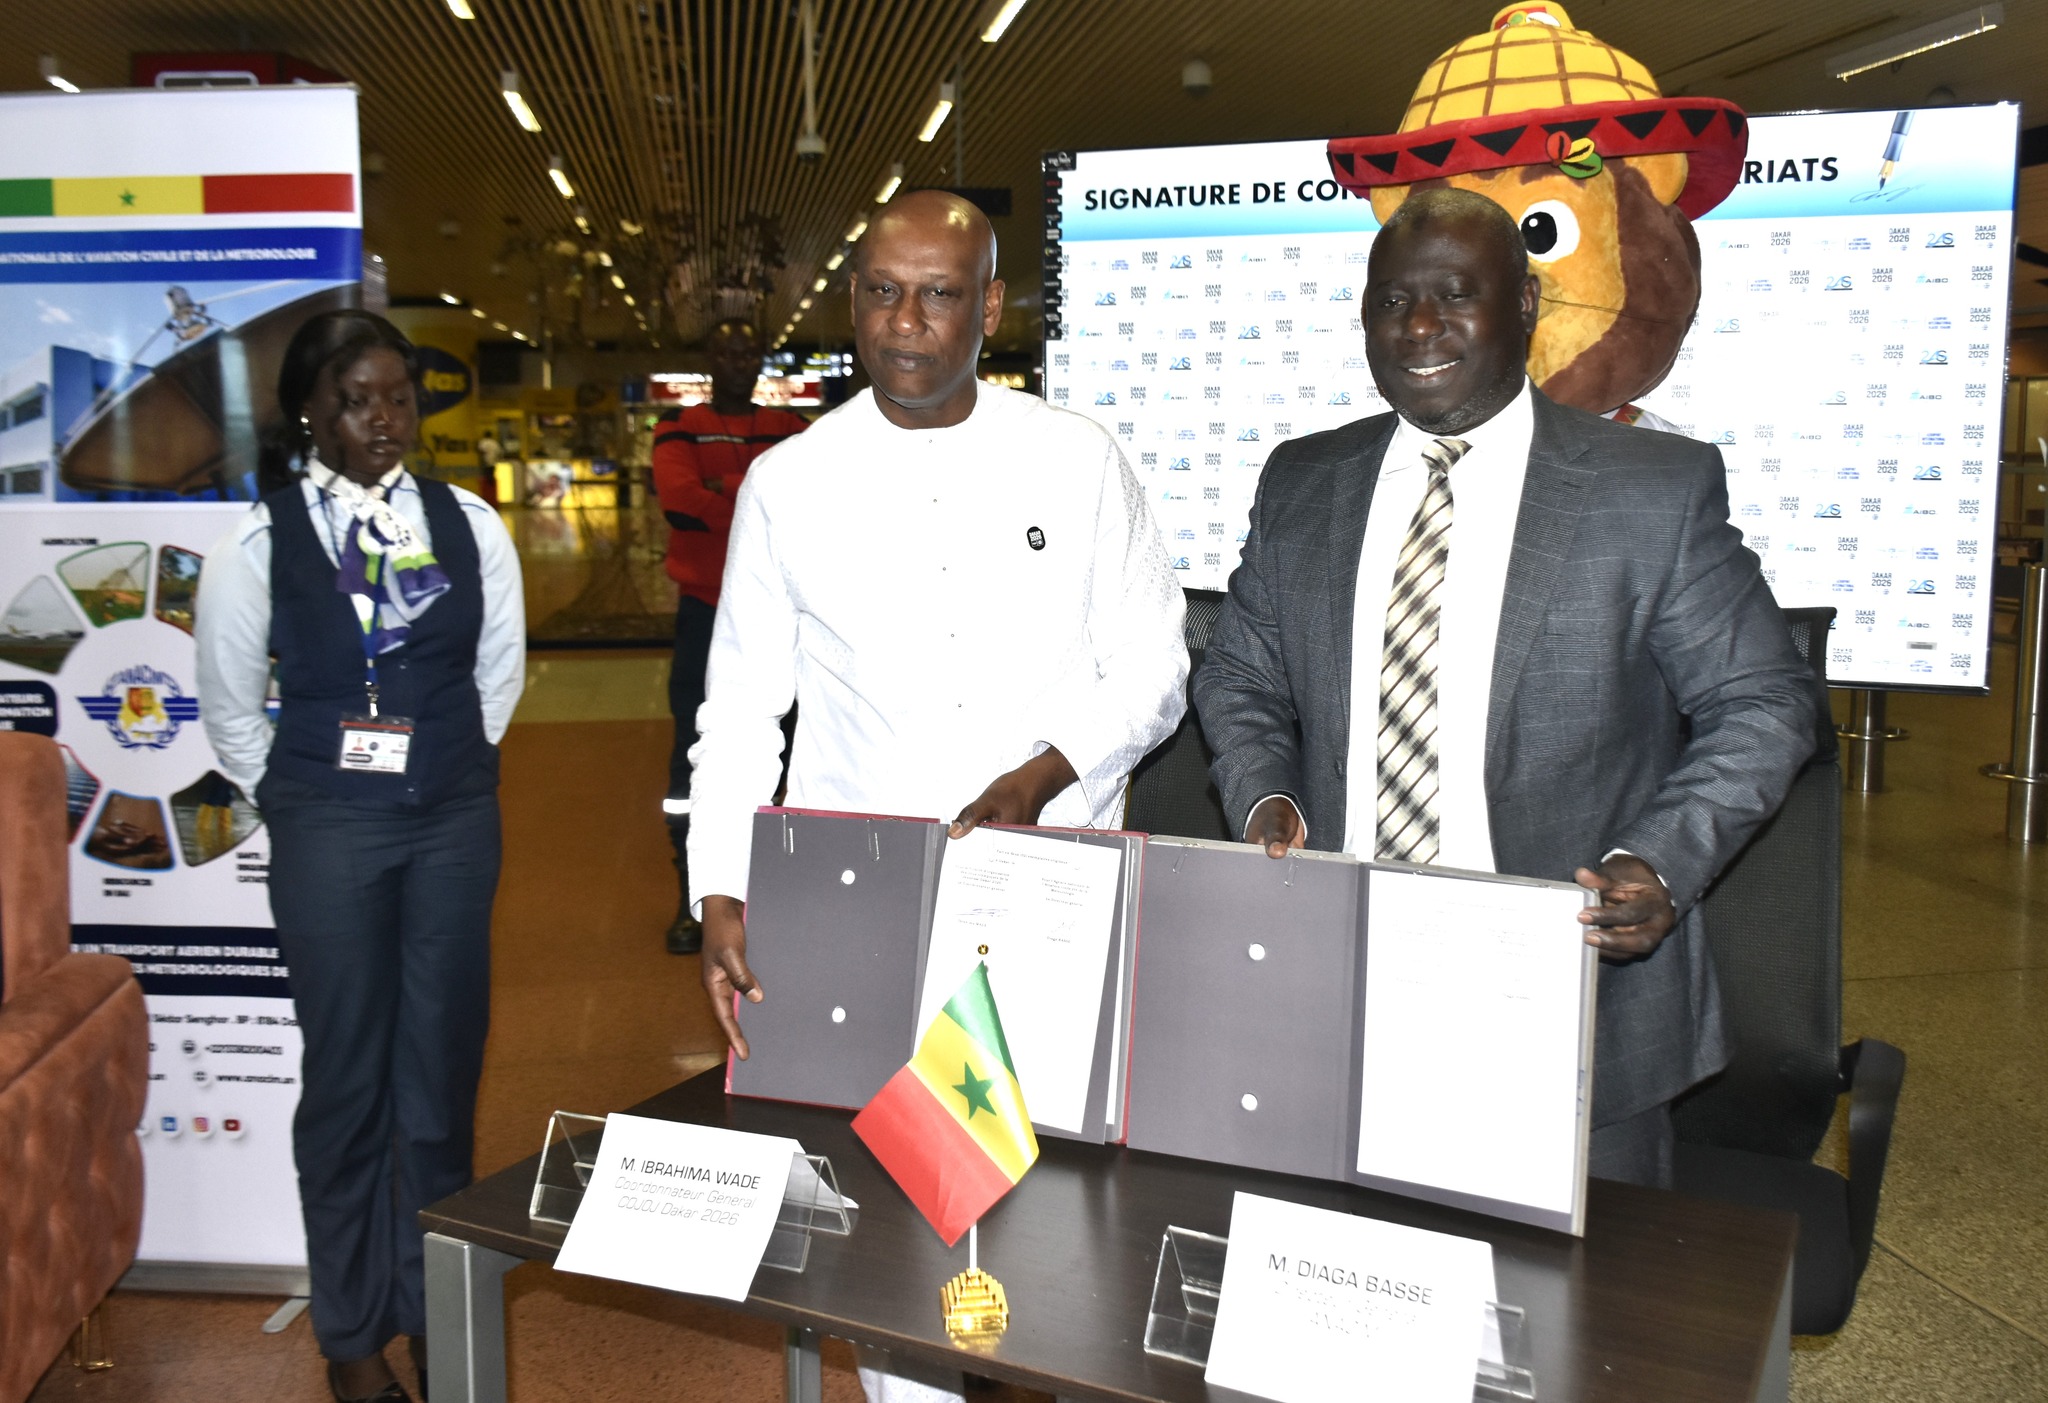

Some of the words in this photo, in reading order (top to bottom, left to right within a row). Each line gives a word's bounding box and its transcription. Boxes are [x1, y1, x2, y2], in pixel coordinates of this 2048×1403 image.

[1085, 183, 1240, 211] SIGNATURE
[1252, 182, 1286, 203] DE
[615, 1176, 705, 1200] Coordonnateur
[620, 1157, 637, 1172] M.
[640, 1160, 711, 1183] IBRAHIMA
[716, 1171, 761, 1190] WADE
[660, 1202, 699, 1219] Dakar
[700, 1208, 740, 1226] 2026
[1268, 1253, 1290, 1274] M.
[1297, 1260, 1358, 1289] DIAGA
[1365, 1275, 1433, 1305] BASSE
